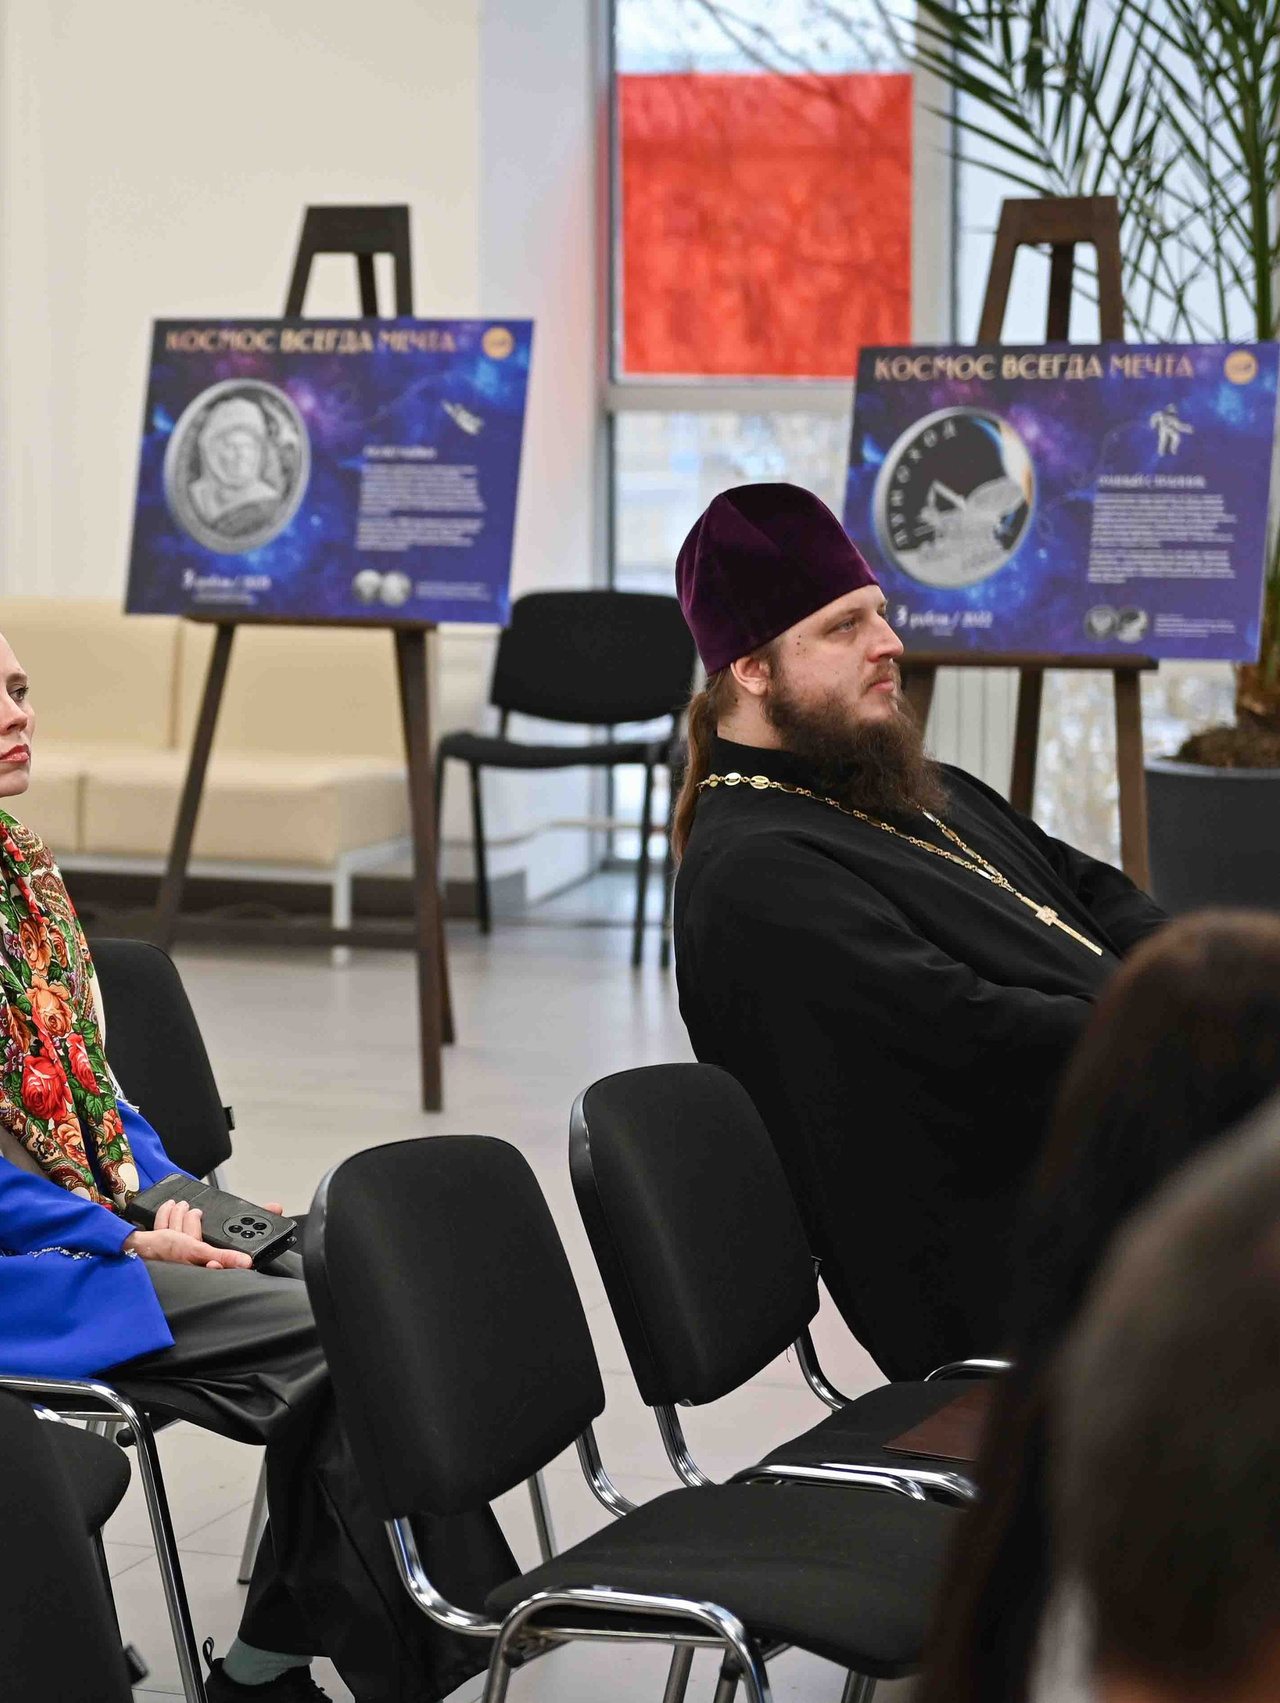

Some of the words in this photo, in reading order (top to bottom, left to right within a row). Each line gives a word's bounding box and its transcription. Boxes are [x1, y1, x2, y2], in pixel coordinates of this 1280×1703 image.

[166, 330, 276, 353] КОСМОС
[280, 330, 374, 354] ВСЕГДА
[377, 329, 457, 353] МЕЧТА
[874, 354, 996, 381] КОСМОС
[1001, 354, 1103, 381] ВСЕГДА
[1109, 353, 1195, 380] МЕЧТА
[896, 604, 907, 628] 3
